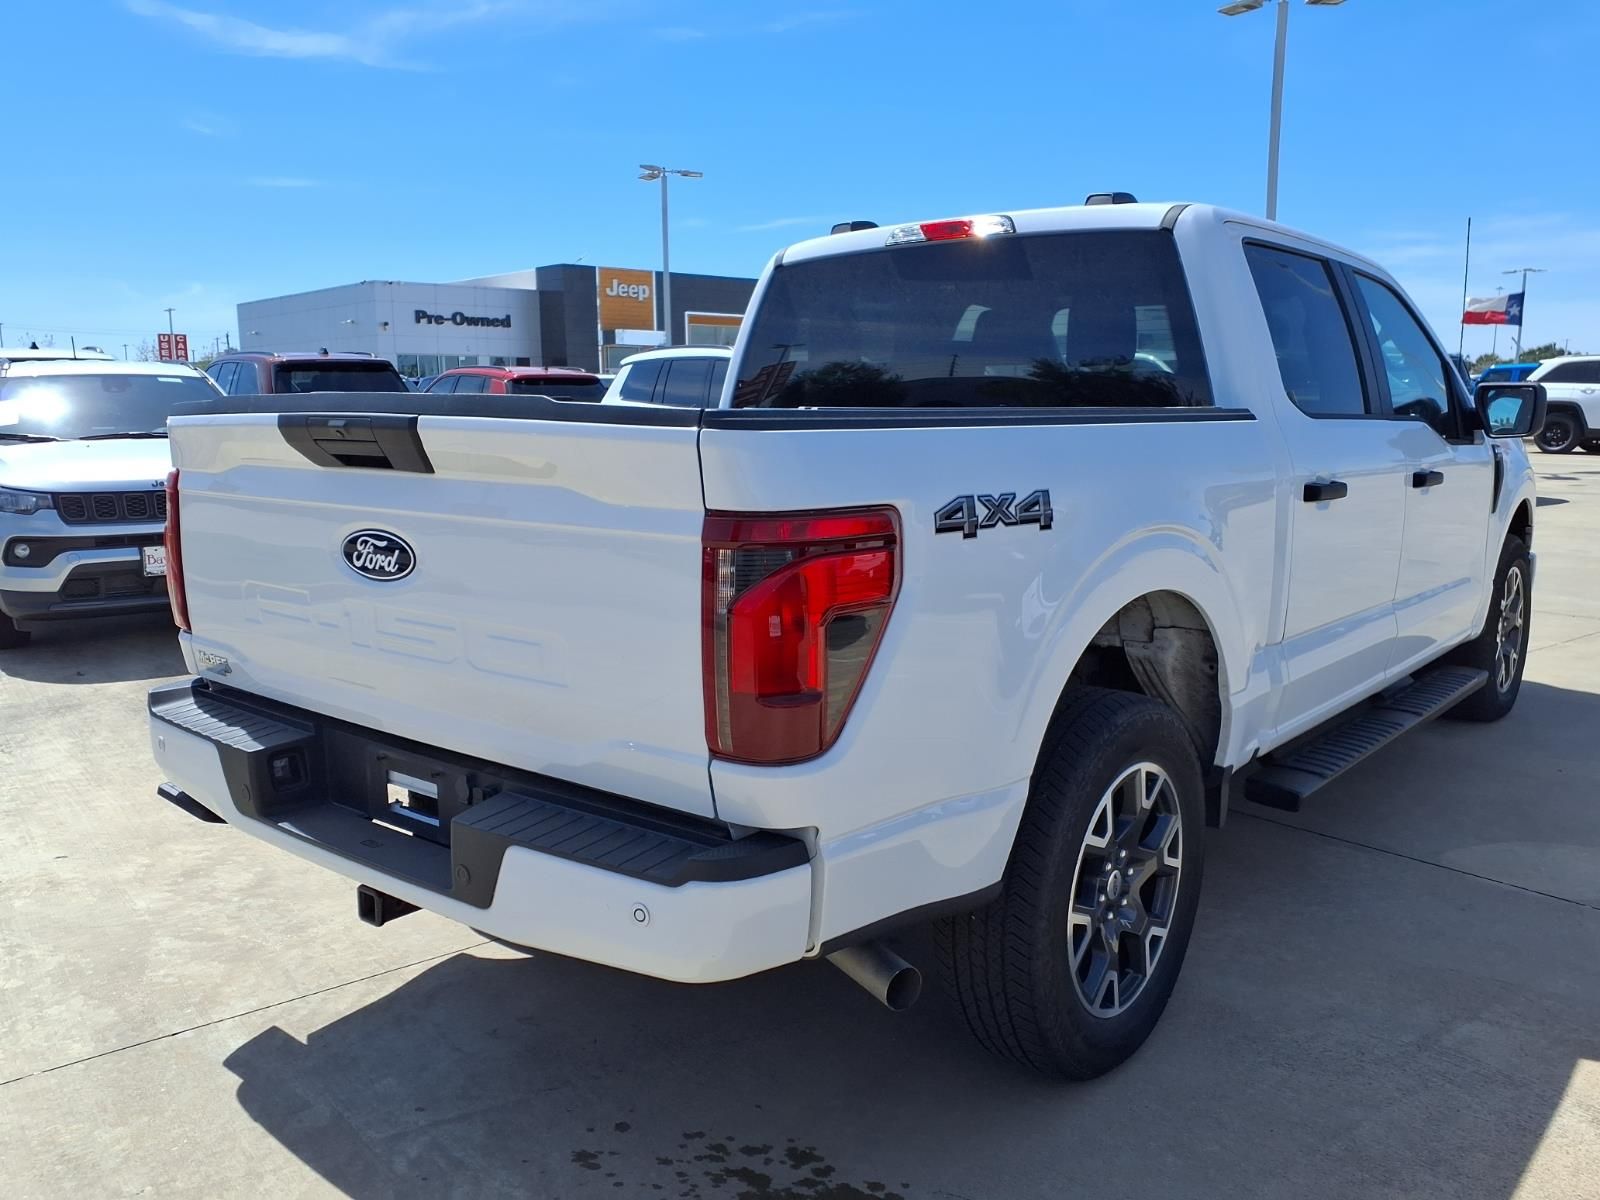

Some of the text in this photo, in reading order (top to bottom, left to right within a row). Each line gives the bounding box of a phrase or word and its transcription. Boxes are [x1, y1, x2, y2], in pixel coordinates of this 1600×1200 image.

[606, 279, 650, 301] Jeep
[414, 309, 512, 328] Pre-Owned
[352, 536, 400, 573] Ford
